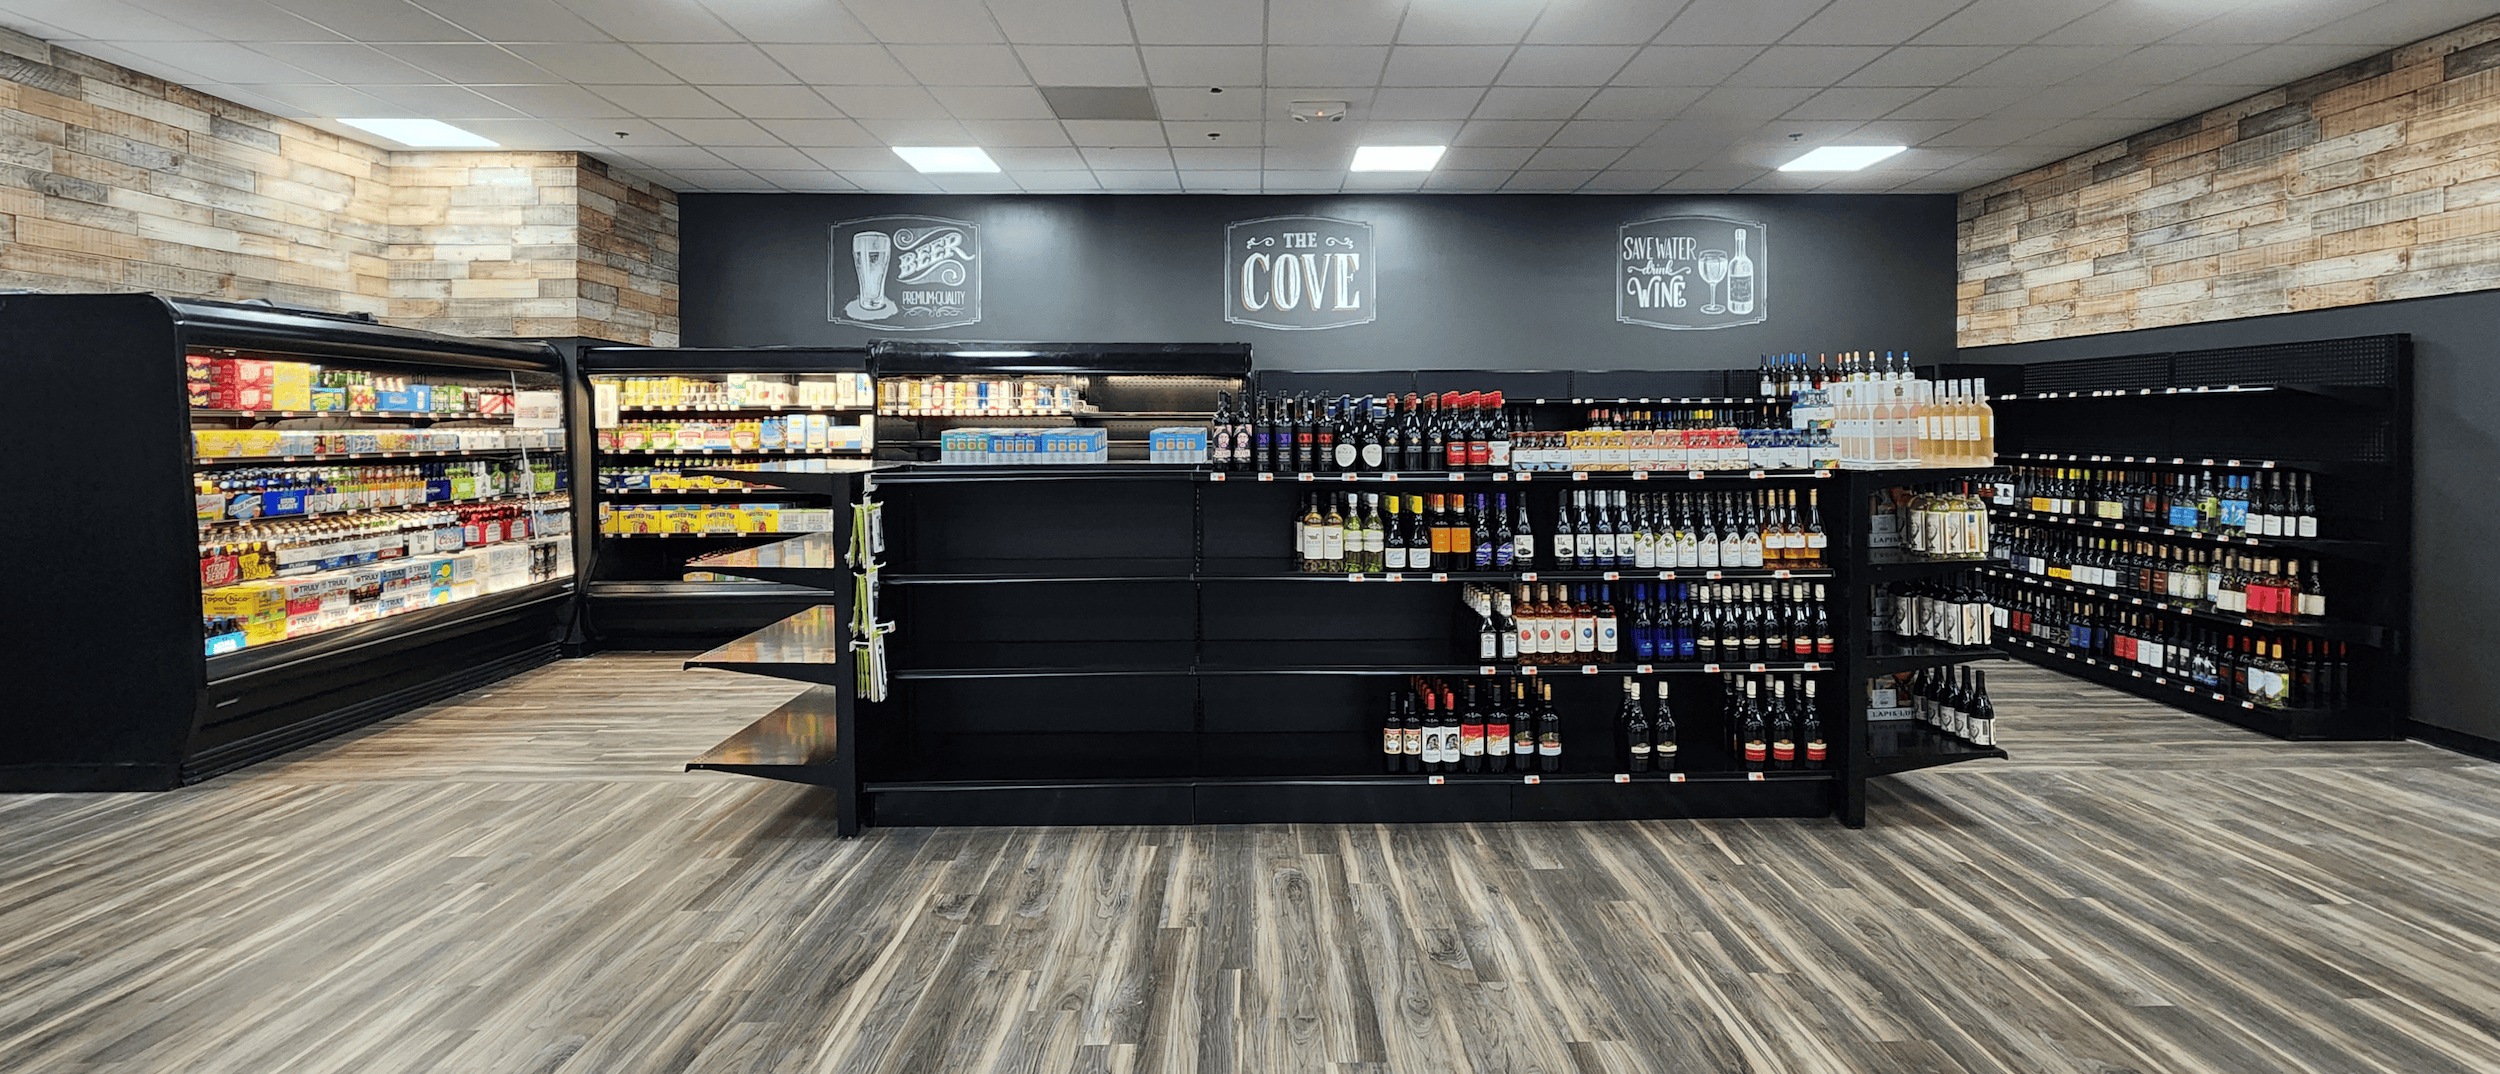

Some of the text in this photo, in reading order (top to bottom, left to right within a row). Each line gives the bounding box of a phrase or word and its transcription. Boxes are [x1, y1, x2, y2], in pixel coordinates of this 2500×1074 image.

[1283, 232, 1318, 249] THE
[1623, 236, 1697, 260] SAVE WATER
[897, 232, 976, 280] BEER
[1632, 260, 1685, 276] drink
[1241, 252, 1360, 312] COVE
[1627, 275, 1688, 308] WINE
[413, 564, 430, 573] TRULY
[328, 577, 348, 587] TRULY
[360, 572, 379, 582] TRULY
[300, 583, 320, 592] TRULY
[386, 598, 404, 607] TRULY
